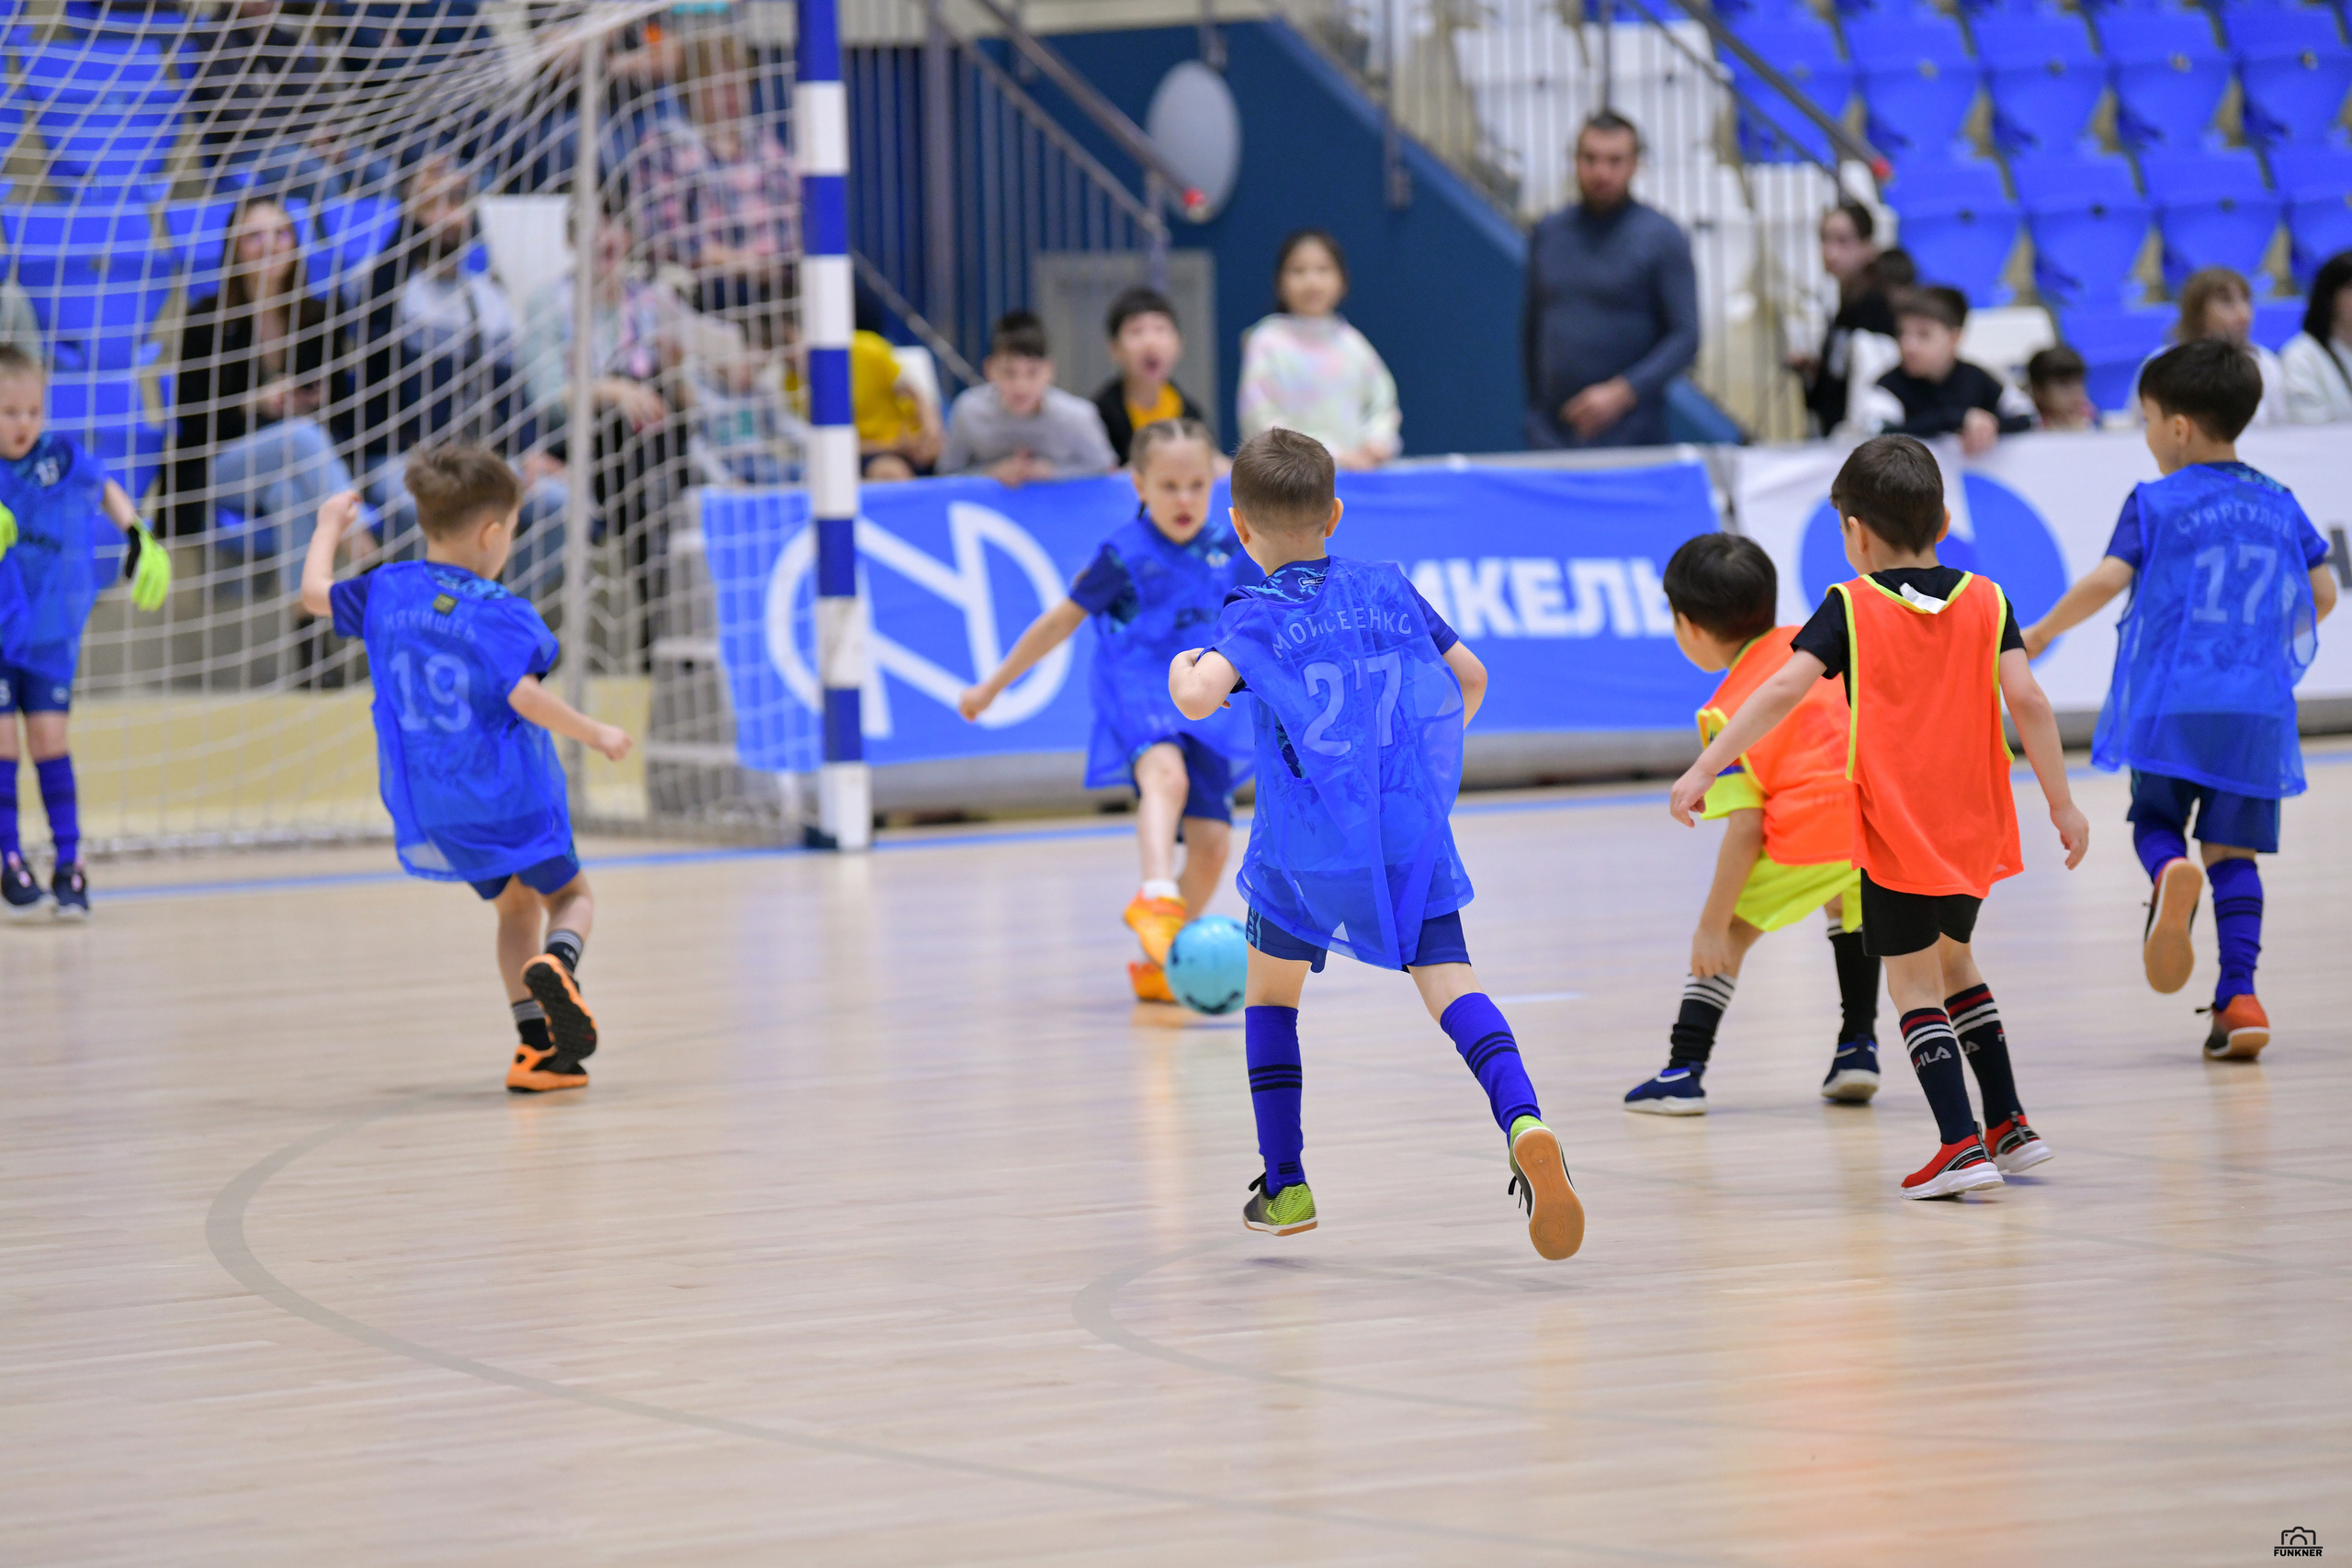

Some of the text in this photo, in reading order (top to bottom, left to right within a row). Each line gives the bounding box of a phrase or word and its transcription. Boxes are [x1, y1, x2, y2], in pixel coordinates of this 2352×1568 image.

[2191, 543, 2277, 625] 17
[1272, 607, 1412, 659] МОИСЕЕНКО
[390, 650, 472, 732] 19
[1302, 650, 1402, 757] 27
[1913, 1045, 1952, 1073] FILA
